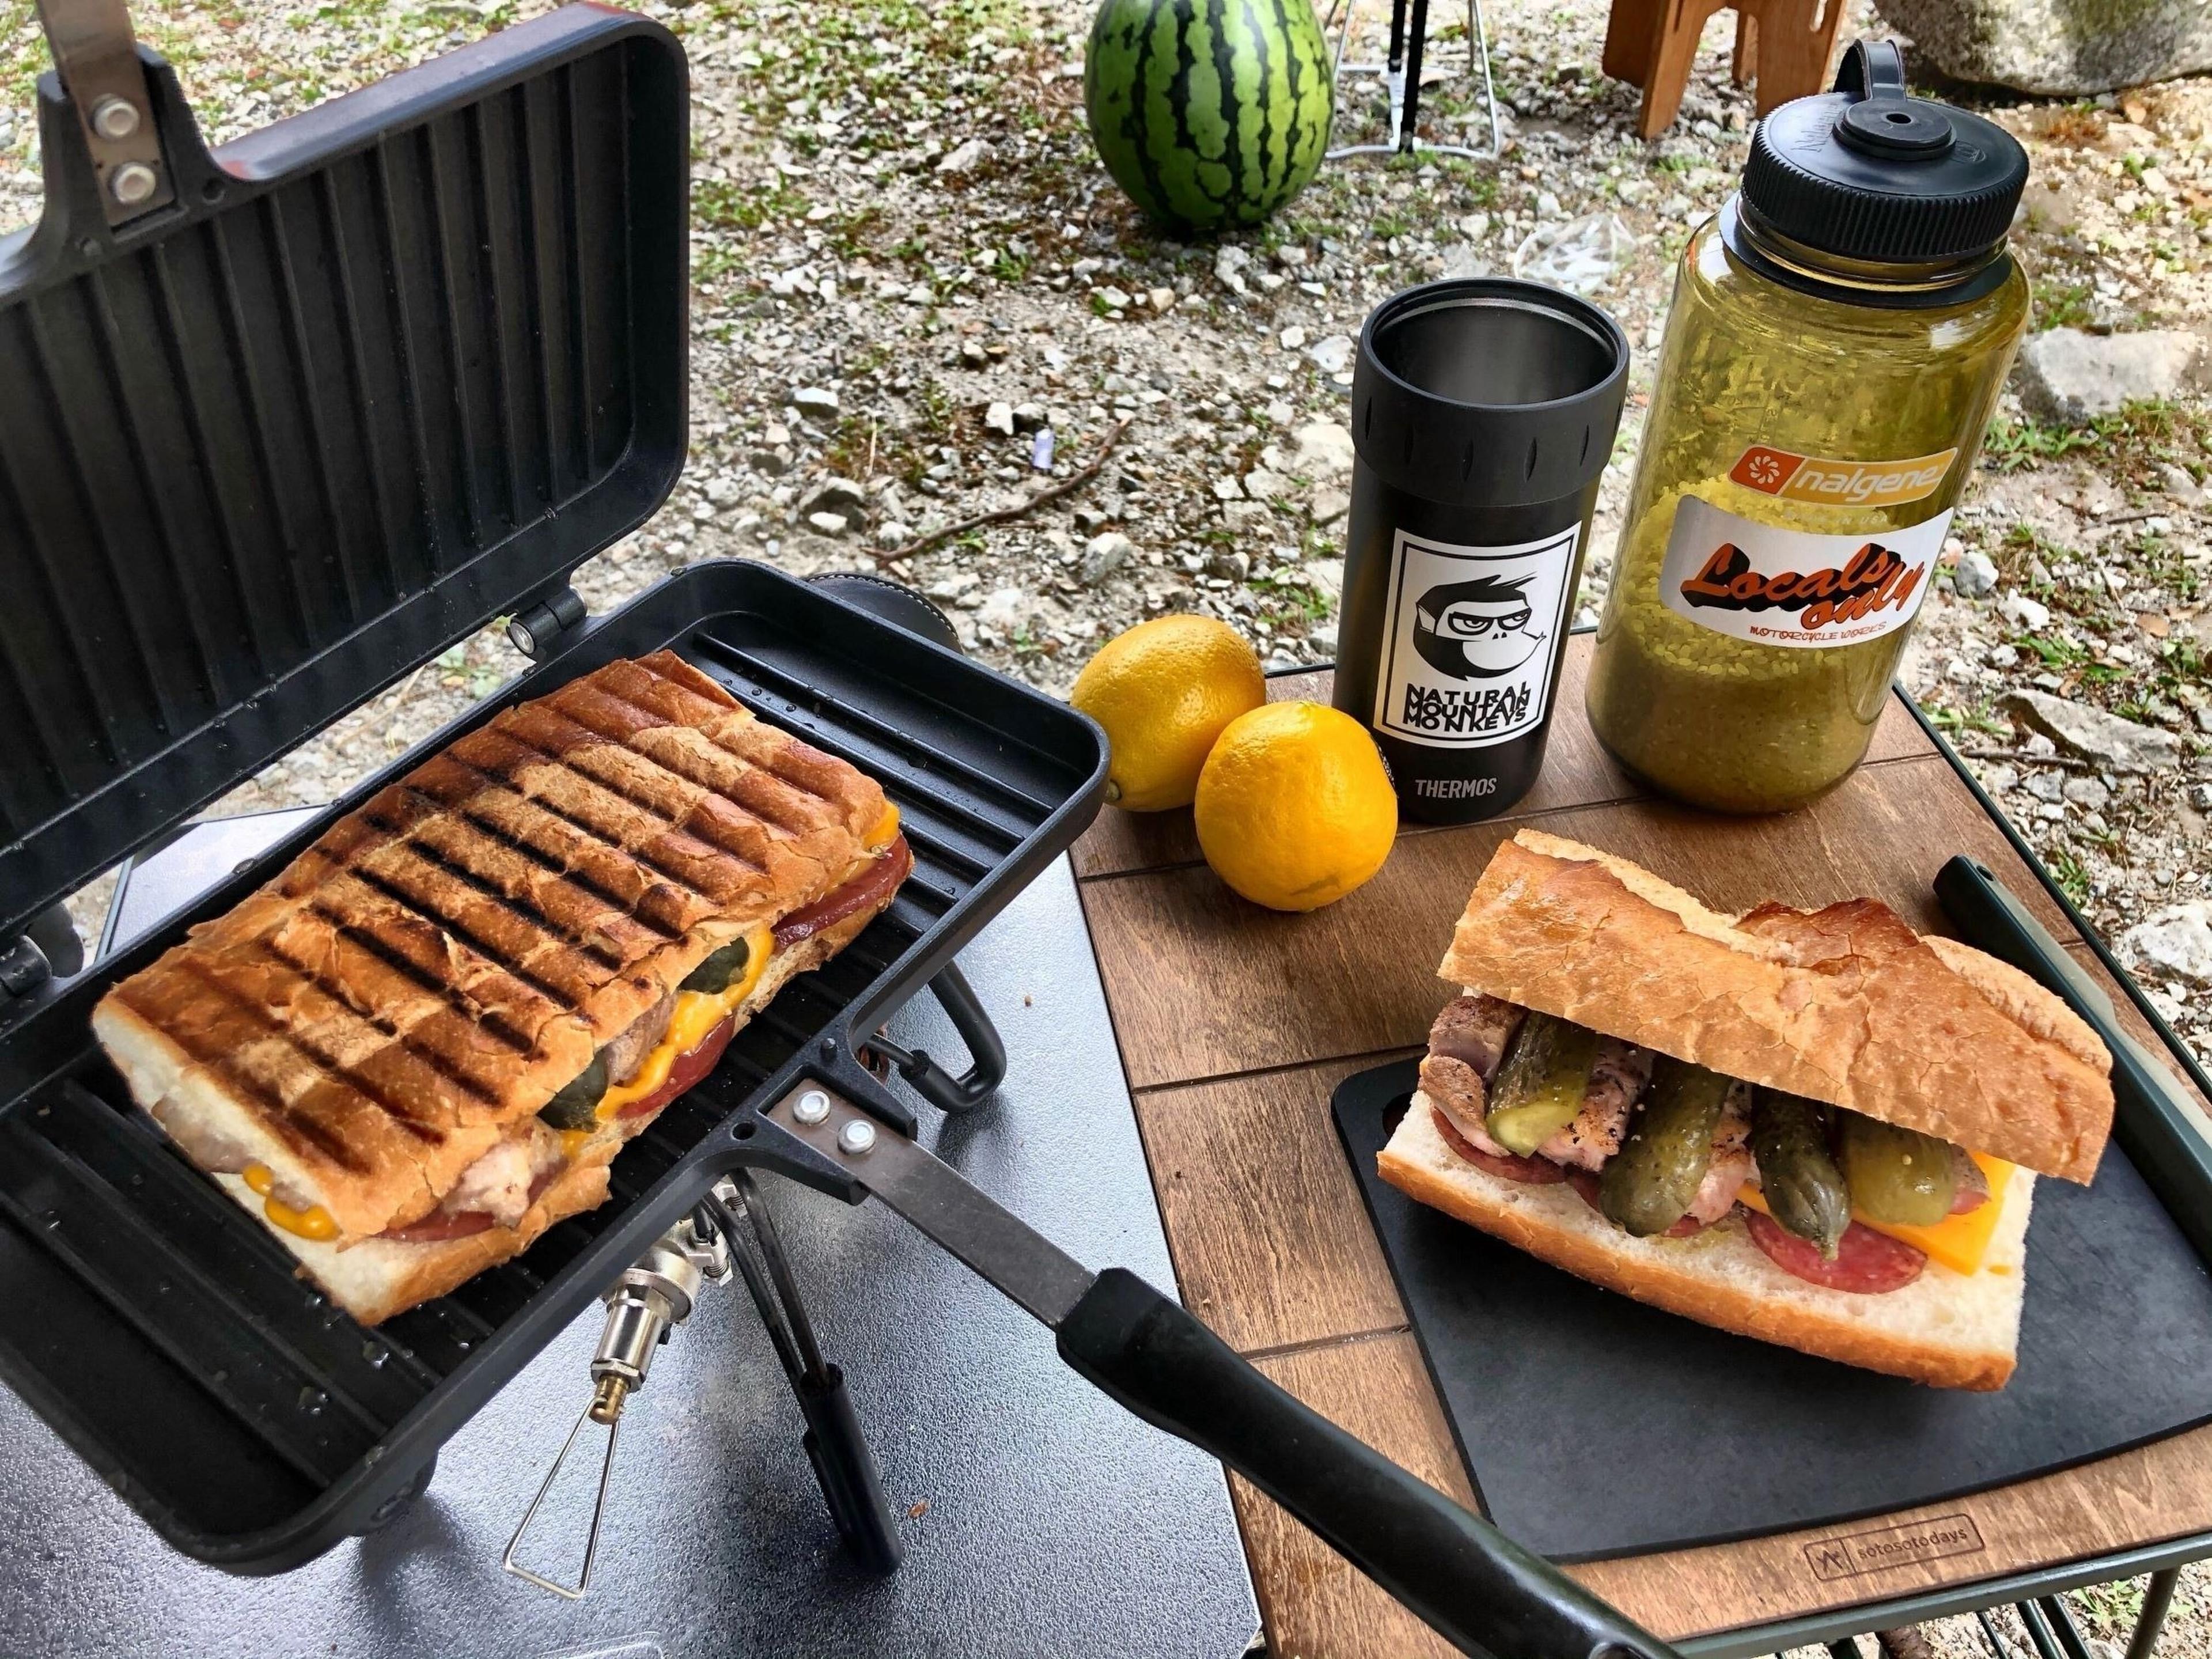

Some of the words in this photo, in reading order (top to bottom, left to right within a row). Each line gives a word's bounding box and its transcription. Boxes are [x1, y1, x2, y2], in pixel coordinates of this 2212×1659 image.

[1796, 466, 1940, 502] nalgene
[1680, 543, 1906, 612] Locals
[1801, 560, 1925, 630] only
[1750, 625, 1839, 643] MOTORCYCLE
[1841, 621, 1887, 639] WORKS
[1405, 681, 1527, 706] NATURAL
[1403, 707, 1527, 732] MONKEYS
[1415, 778, 1498, 798] THERMOS
